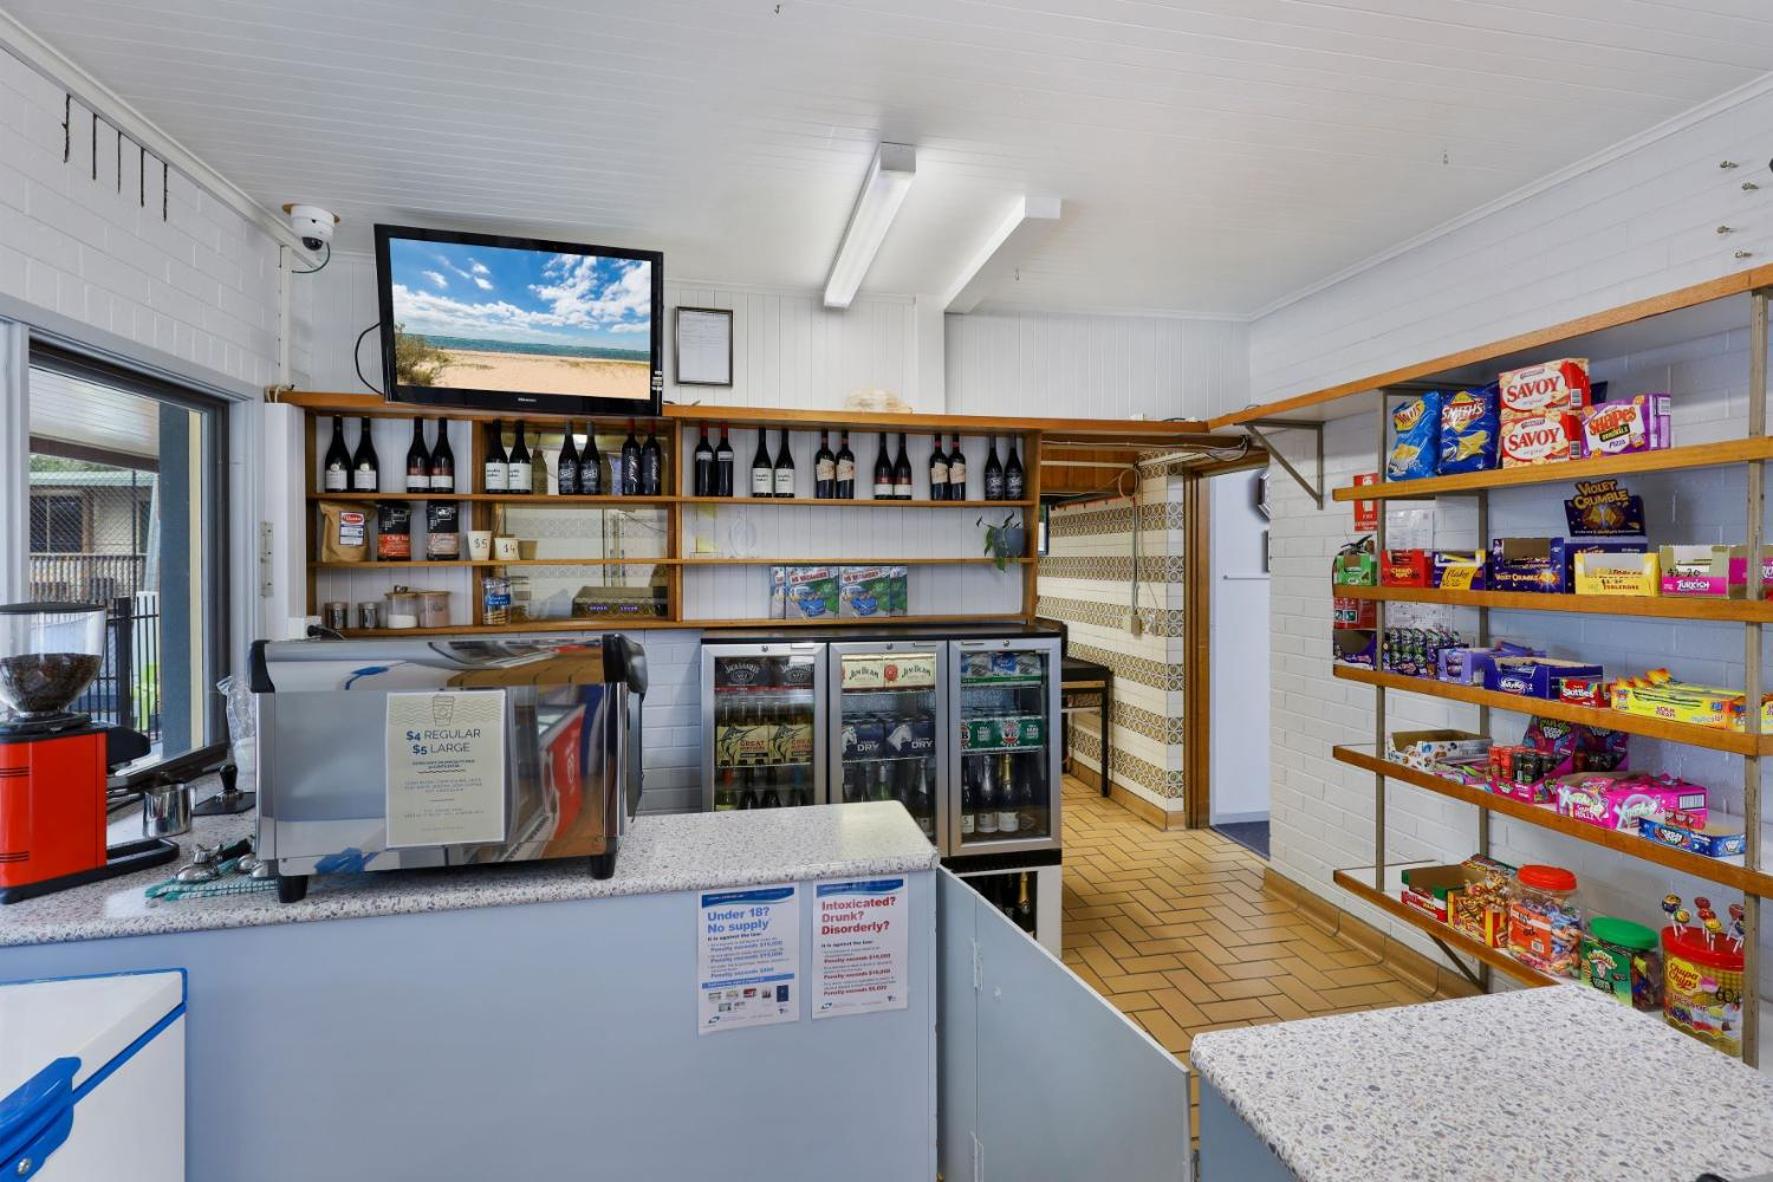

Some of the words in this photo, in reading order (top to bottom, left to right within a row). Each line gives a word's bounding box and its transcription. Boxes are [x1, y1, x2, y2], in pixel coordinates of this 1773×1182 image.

[1507, 376, 1560, 402] SAVOY
[1508, 427, 1560, 451] SAVOY
[1577, 480, 1617, 496] VIOLET
[1574, 490, 1629, 509] CRUMBLE
[406, 731, 421, 741] $4
[424, 728, 481, 740] REGULAR
[412, 744, 427, 755] $5
[430, 742, 471, 754] LARGE
[857, 742, 880, 752] DRY
[911, 740, 933, 749] DRY
[822, 896, 896, 911] Intoxicated?
[707, 910, 745, 921] Under
[750, 907, 770, 917] 18?
[822, 911, 865, 922] Drunk?
[707, 924, 725, 933] No
[729, 919, 769, 931] supply
[821, 920, 890, 935] Disorderly?
